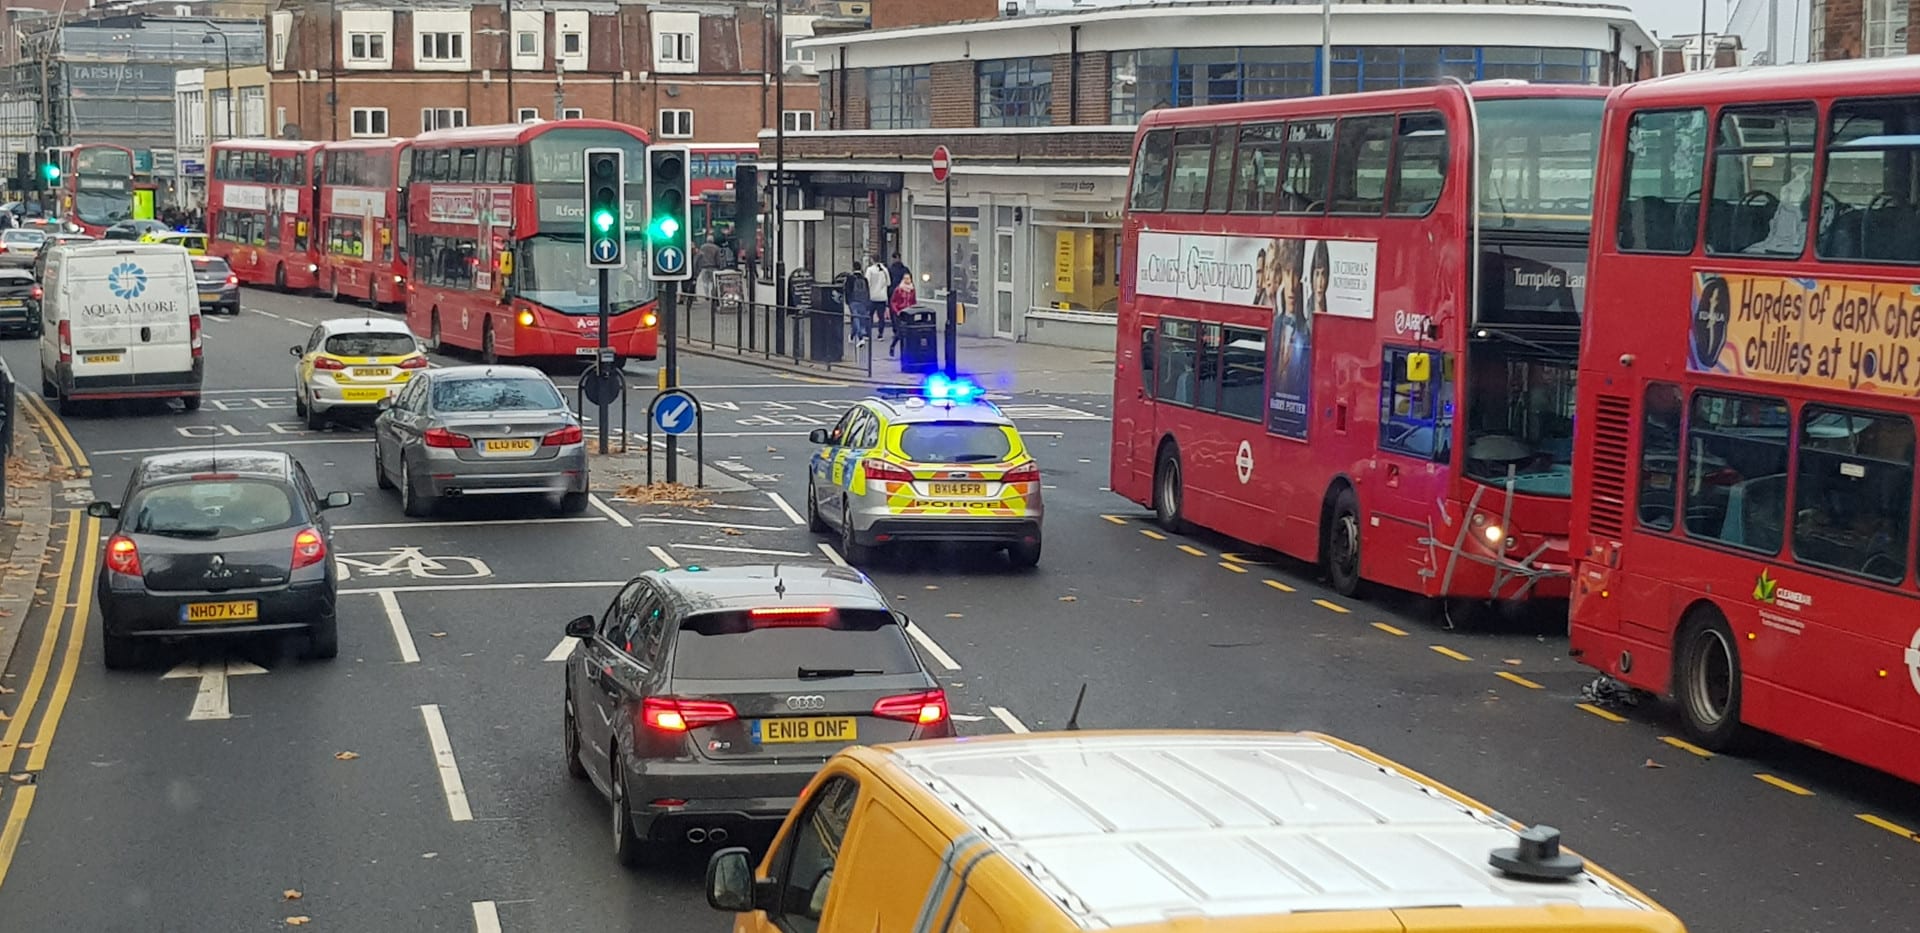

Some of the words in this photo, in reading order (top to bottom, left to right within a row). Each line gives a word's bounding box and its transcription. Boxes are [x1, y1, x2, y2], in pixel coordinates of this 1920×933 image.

[1513, 268, 1561, 291] Turnpike
[82, 303, 122, 317] AQUA
[125, 300, 178, 314] AMORE
[1745, 318, 1812, 376] chillies
[1816, 338, 1842, 380] at
[934, 485, 958, 494] BX14
[960, 484, 981, 493] EFR
[916, 501, 1000, 509] POLICE
[190, 604, 225, 618] NH07
[228, 603, 253, 617] KJF
[768, 722, 808, 738] EN18
[814, 720, 849, 736] ONF
